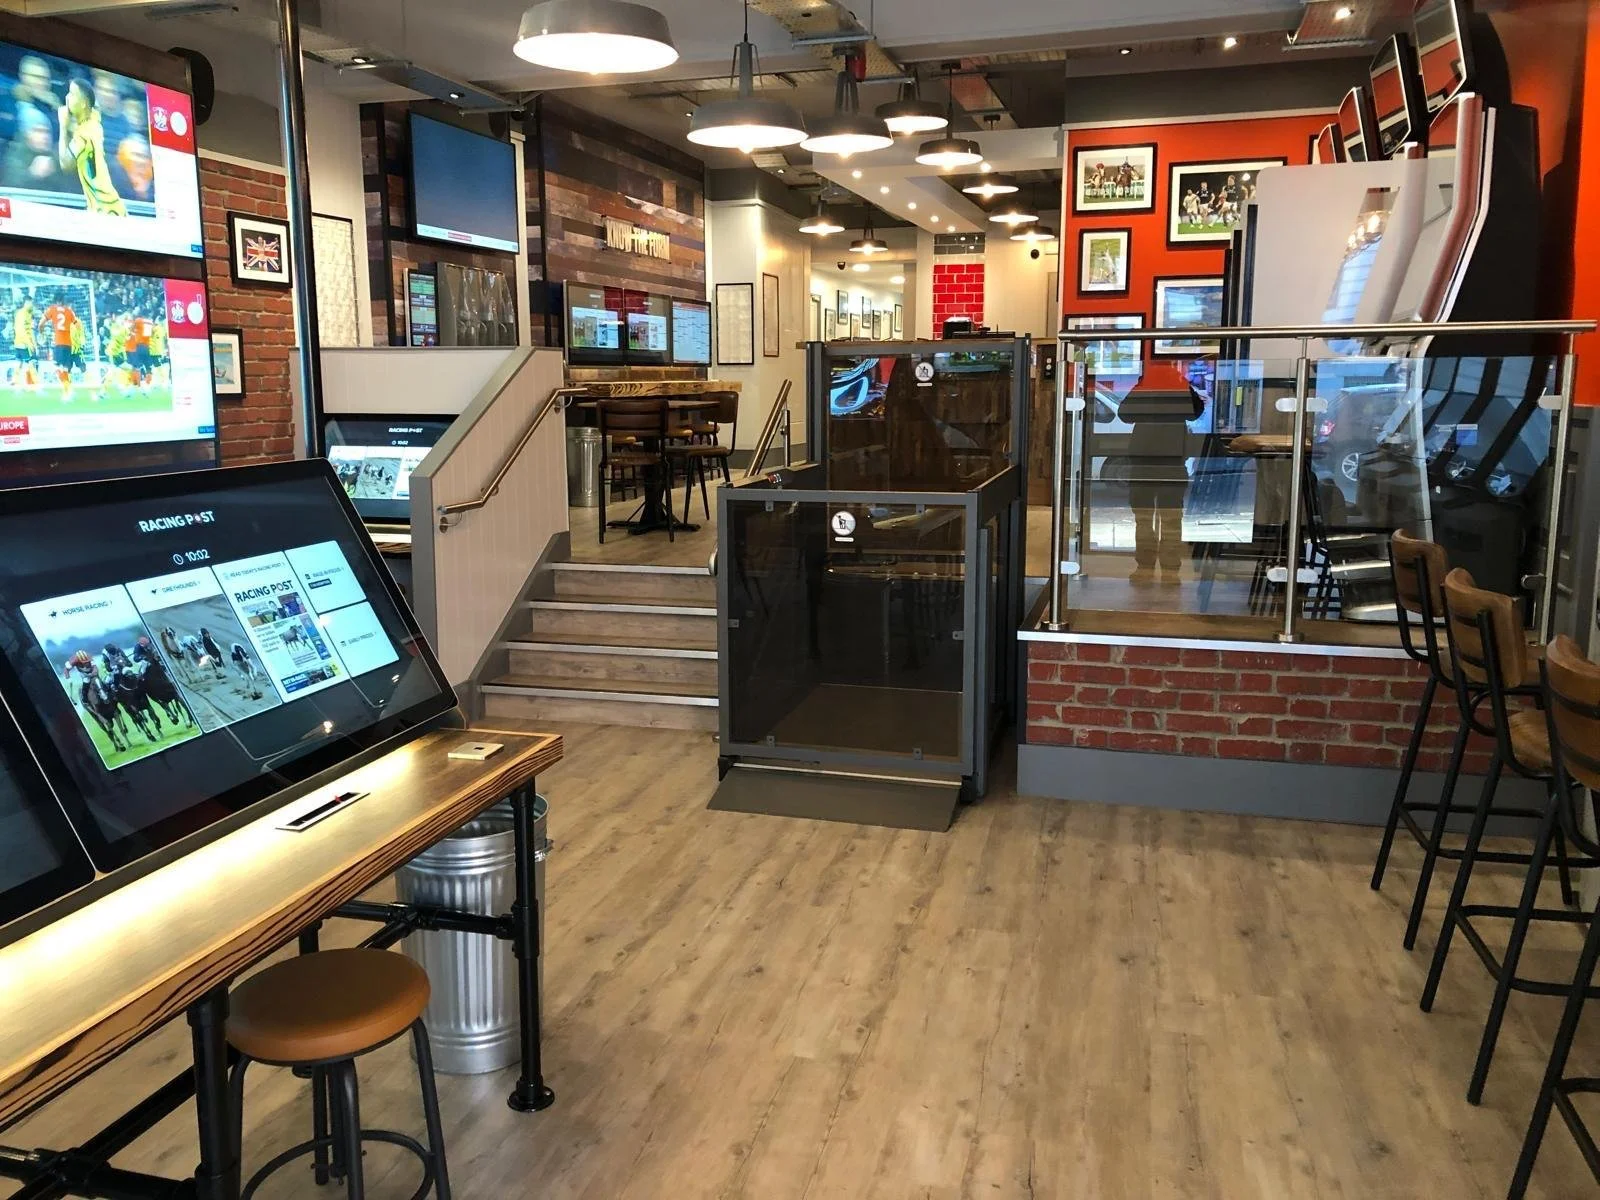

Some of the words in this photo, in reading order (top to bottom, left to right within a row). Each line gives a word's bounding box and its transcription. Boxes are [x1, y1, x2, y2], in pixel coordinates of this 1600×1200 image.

[606, 219, 632, 252] KNOW
[633, 227, 649, 255] THE
[649, 231, 670, 260] FORM
[138, 515, 186, 533] RACING
[185, 549, 210, 562] 10:02
[234, 587, 271, 603] RACING
[269, 580, 294, 594] POST
[62, 606, 85, 616] HORSE
[84, 601, 108, 611] RACING
